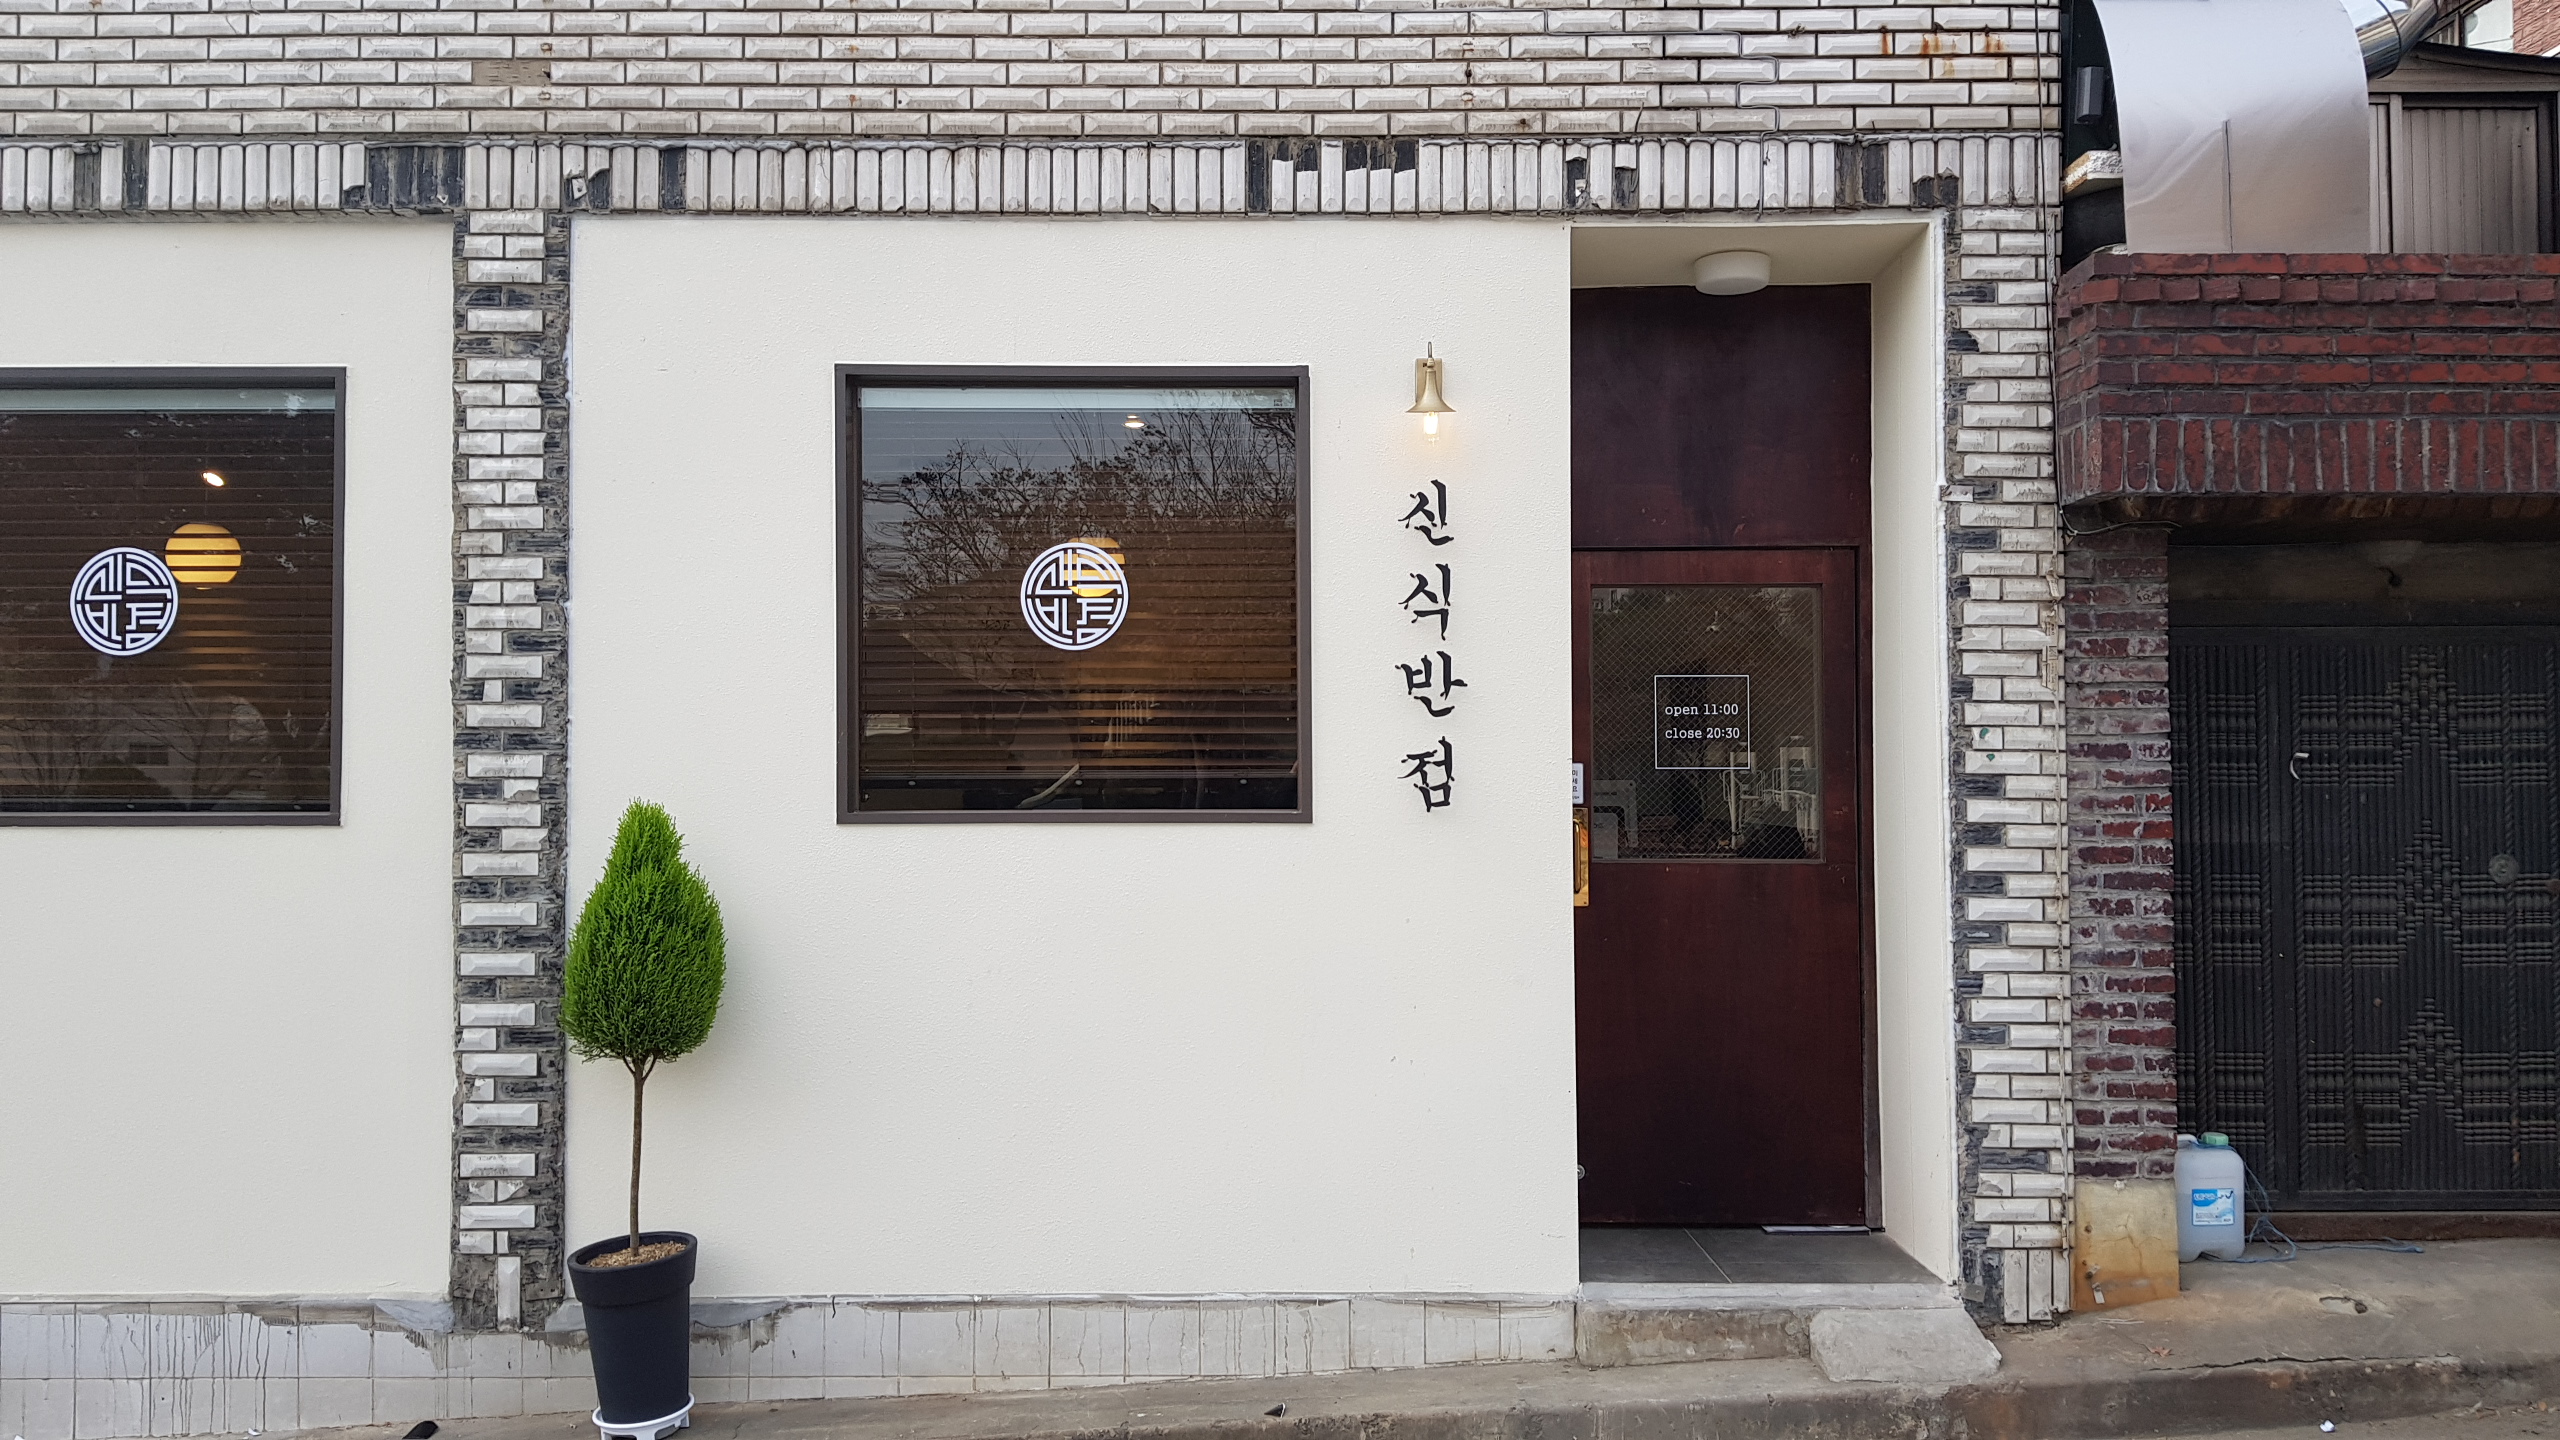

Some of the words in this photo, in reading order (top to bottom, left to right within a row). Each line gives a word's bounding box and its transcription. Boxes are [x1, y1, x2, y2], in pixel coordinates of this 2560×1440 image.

[1395, 479, 1468, 813] 신식반점
[1665, 706, 1699, 717] open
[1703, 703, 1739, 715] 11:00
[1665, 727, 1702, 739] close
[1706, 727, 1740, 739] 20:30
